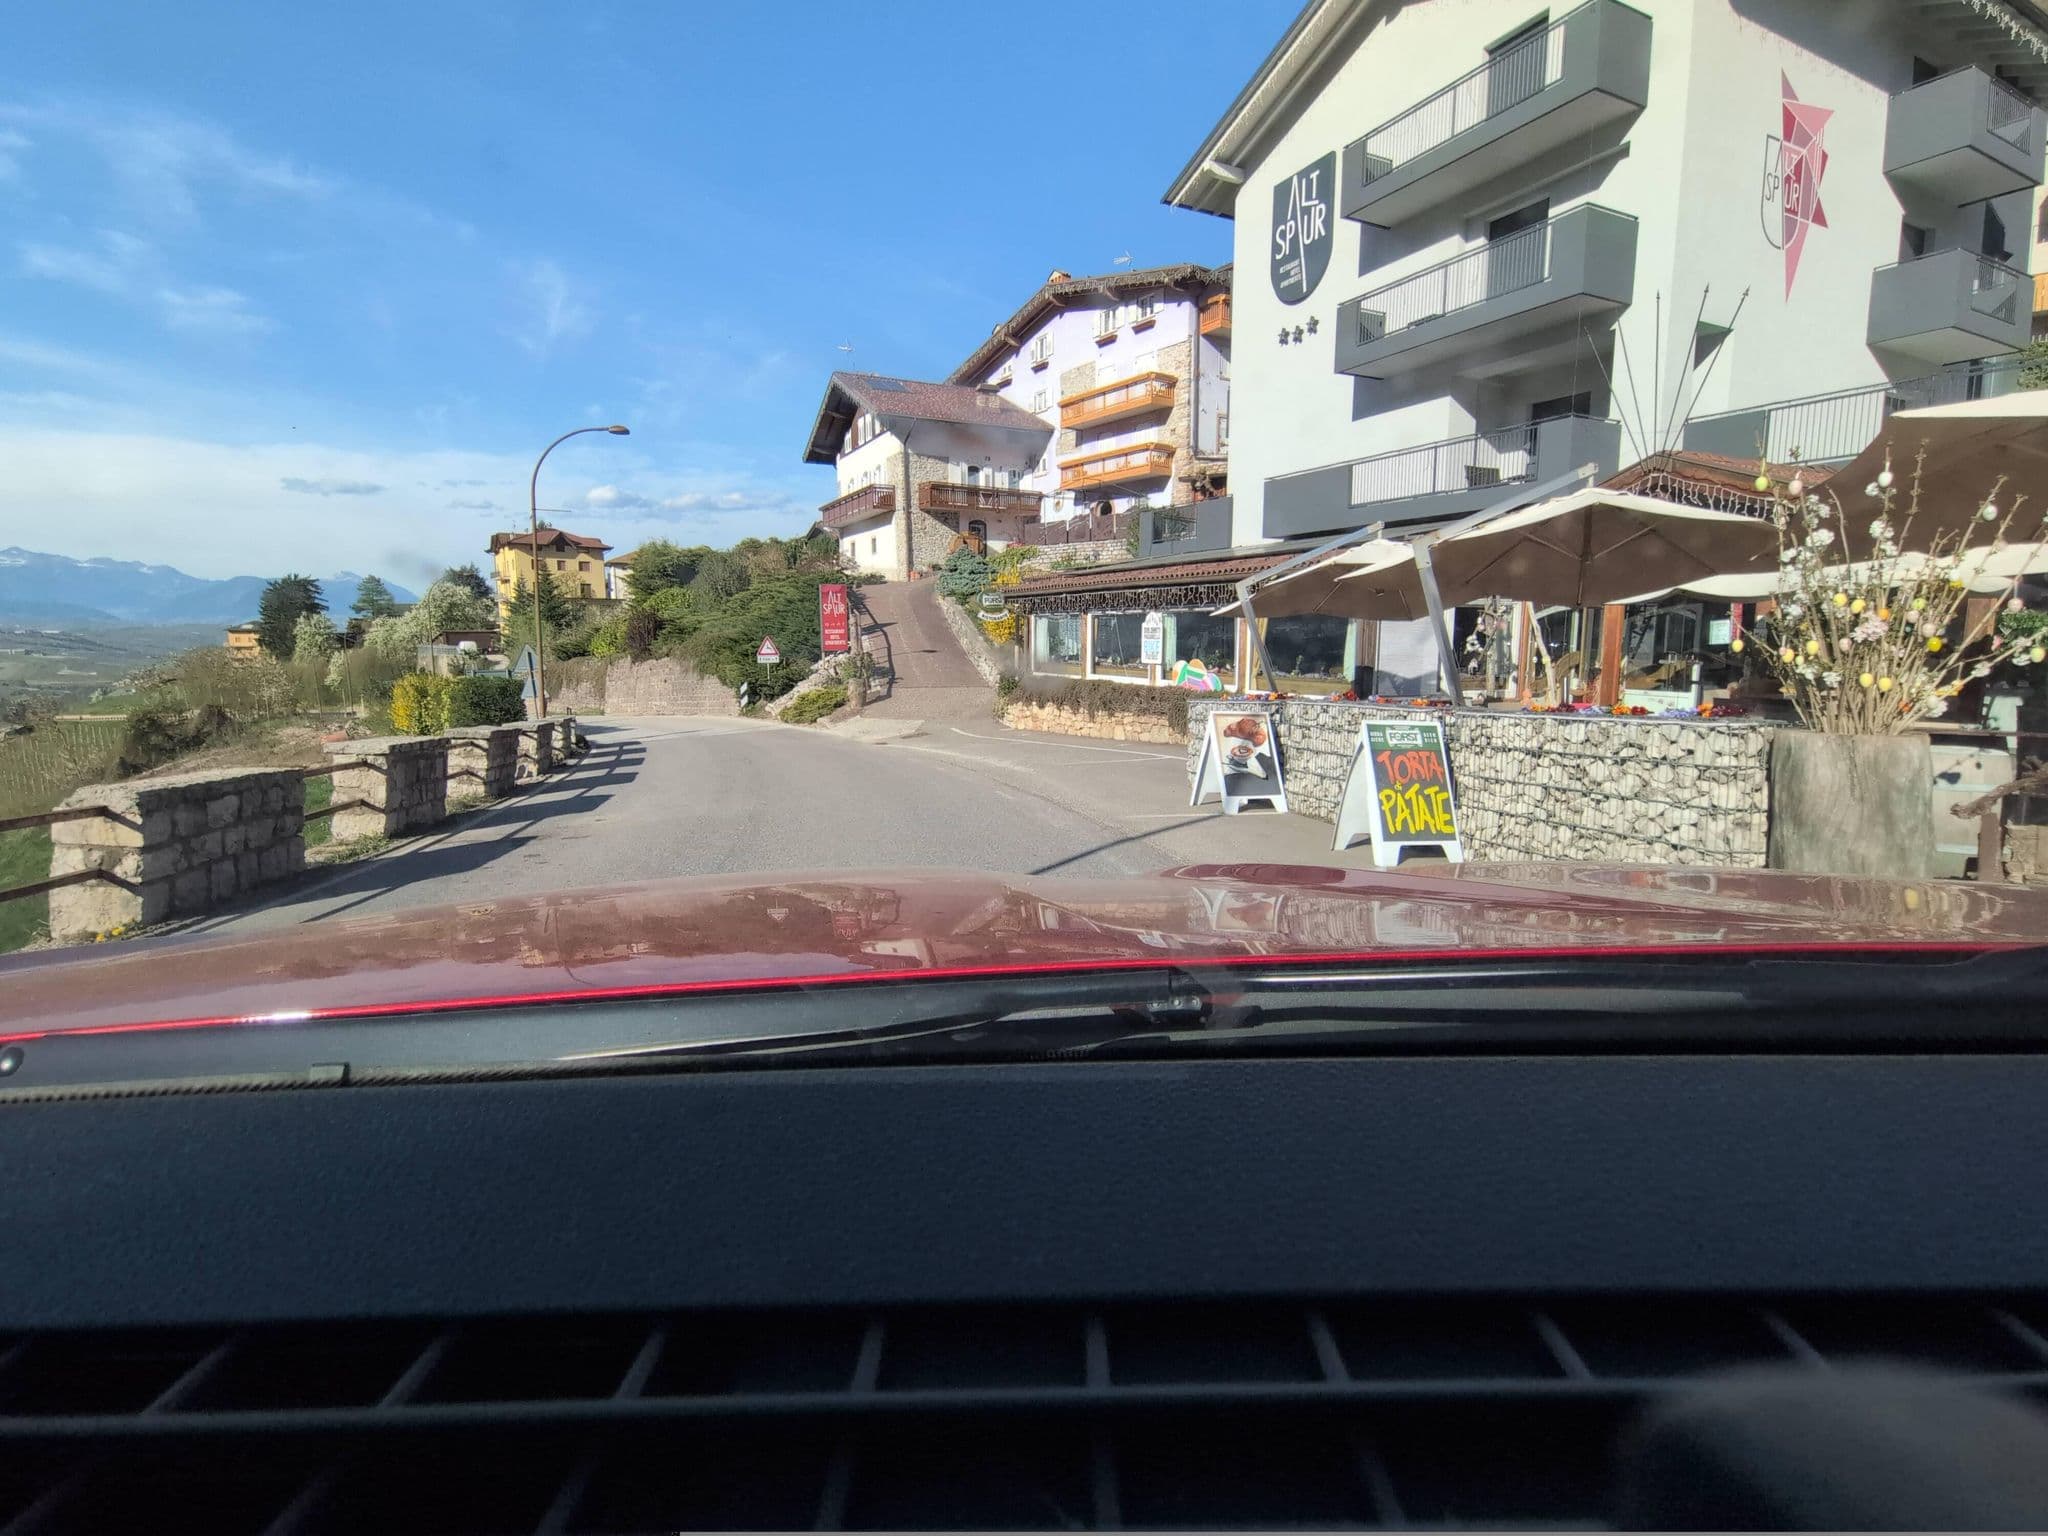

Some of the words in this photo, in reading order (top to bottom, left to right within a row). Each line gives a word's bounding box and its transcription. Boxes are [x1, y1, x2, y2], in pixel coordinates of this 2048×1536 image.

[1389, 731, 1418, 742] FORST
[1376, 750, 1444, 784] TORTA
[1379, 783, 1455, 835] PATATE
